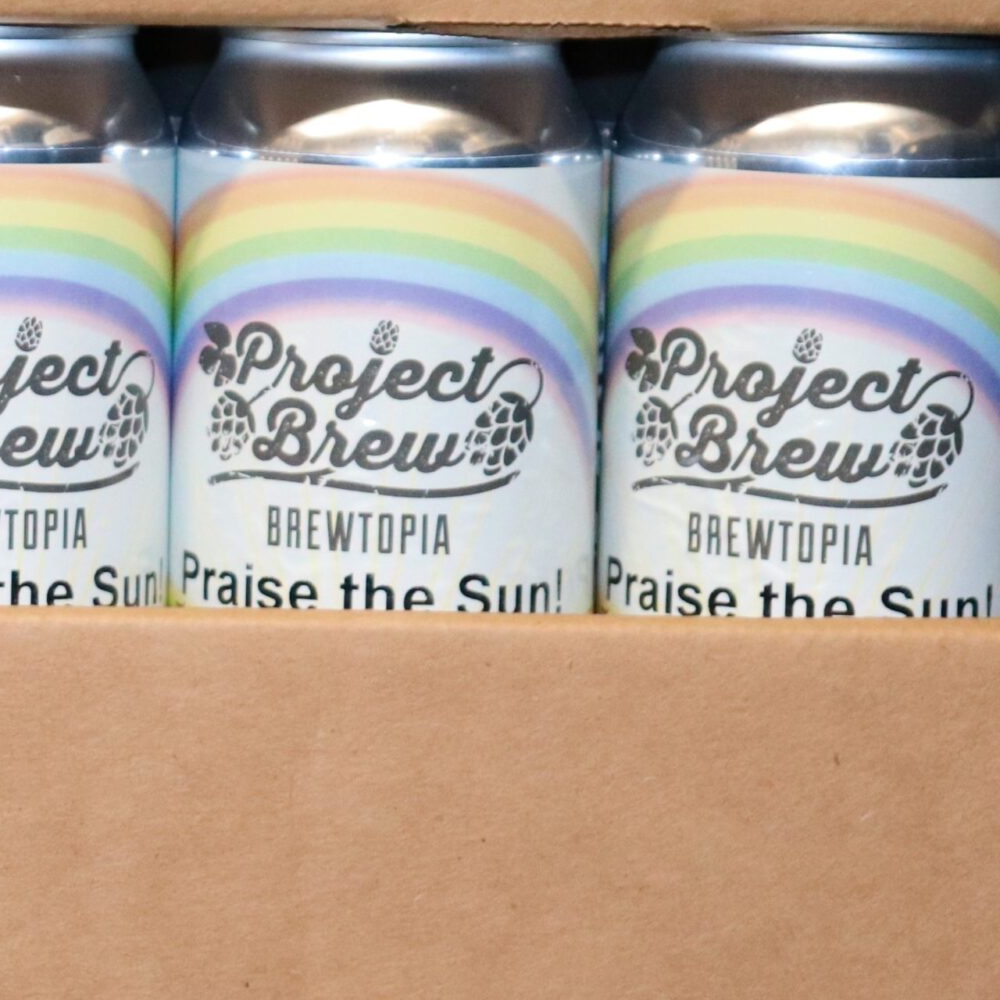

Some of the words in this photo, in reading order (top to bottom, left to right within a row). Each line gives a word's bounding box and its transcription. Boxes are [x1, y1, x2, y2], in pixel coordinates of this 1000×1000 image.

[235, 321, 495, 420] Project
[660, 327, 922, 428] Project
[251, 397, 466, 473] Brew
[674, 404, 891, 483] Brew
[266, 504, 452, 556] BREWTOPIA
[687, 511, 873, 567] BREWTOPIA
[181, 549, 319, 609] Praise
[339, 573, 436, 611] the
[457, 567, 563, 614] Sun!
[606, 556, 738, 618] Praise
[758, 581, 856, 618] the
